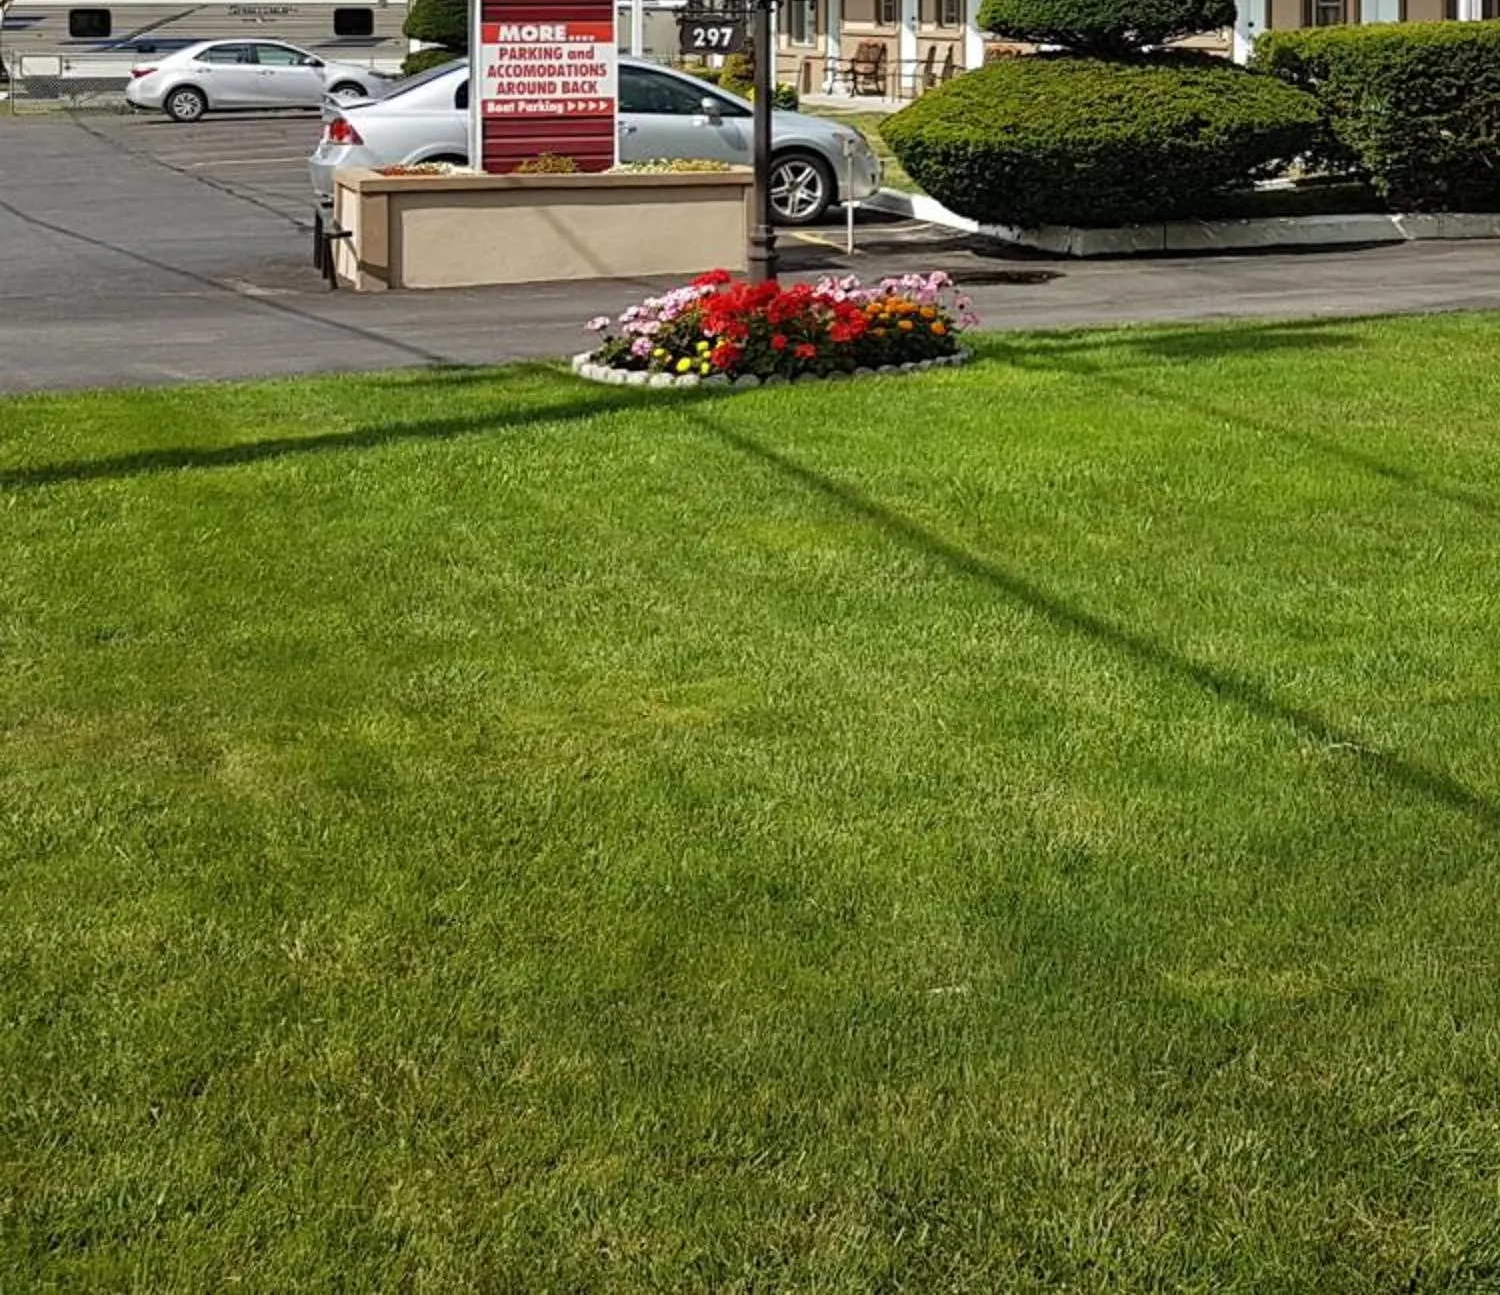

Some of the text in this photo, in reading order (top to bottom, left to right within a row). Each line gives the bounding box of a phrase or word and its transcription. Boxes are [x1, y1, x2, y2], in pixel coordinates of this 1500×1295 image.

[693, 27, 733, 47] 297
[499, 45, 594, 61] PARKING and
[487, 63, 607, 78] ACCOMODATIONS
[496, 80, 598, 95] AROUND BACK
[517, 100, 564, 114] Parking
